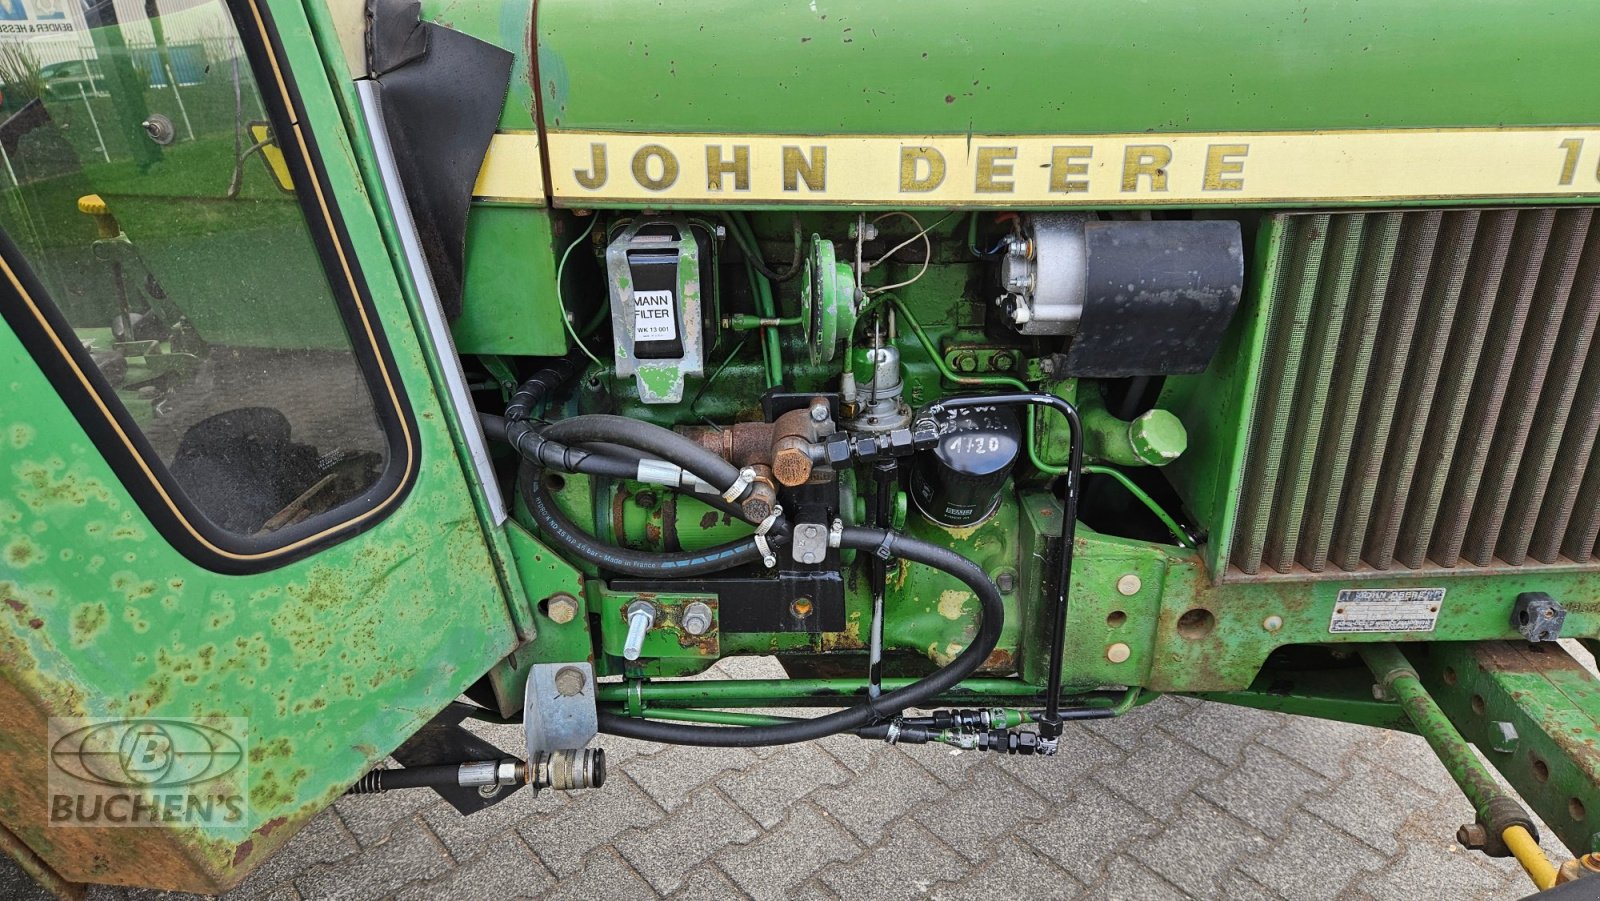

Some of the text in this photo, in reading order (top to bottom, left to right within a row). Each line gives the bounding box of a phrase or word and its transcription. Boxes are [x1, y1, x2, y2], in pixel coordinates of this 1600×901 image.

[572, 142, 828, 193] JOHN
[899, 143, 1250, 193] DEERE
[634, 295, 668, 306] MANN
[635, 309, 669, 319] FILTER
[586, 547, 598, 557] bar
[603, 554, 623, 565] Made
[633, 560, 656, 568] France
